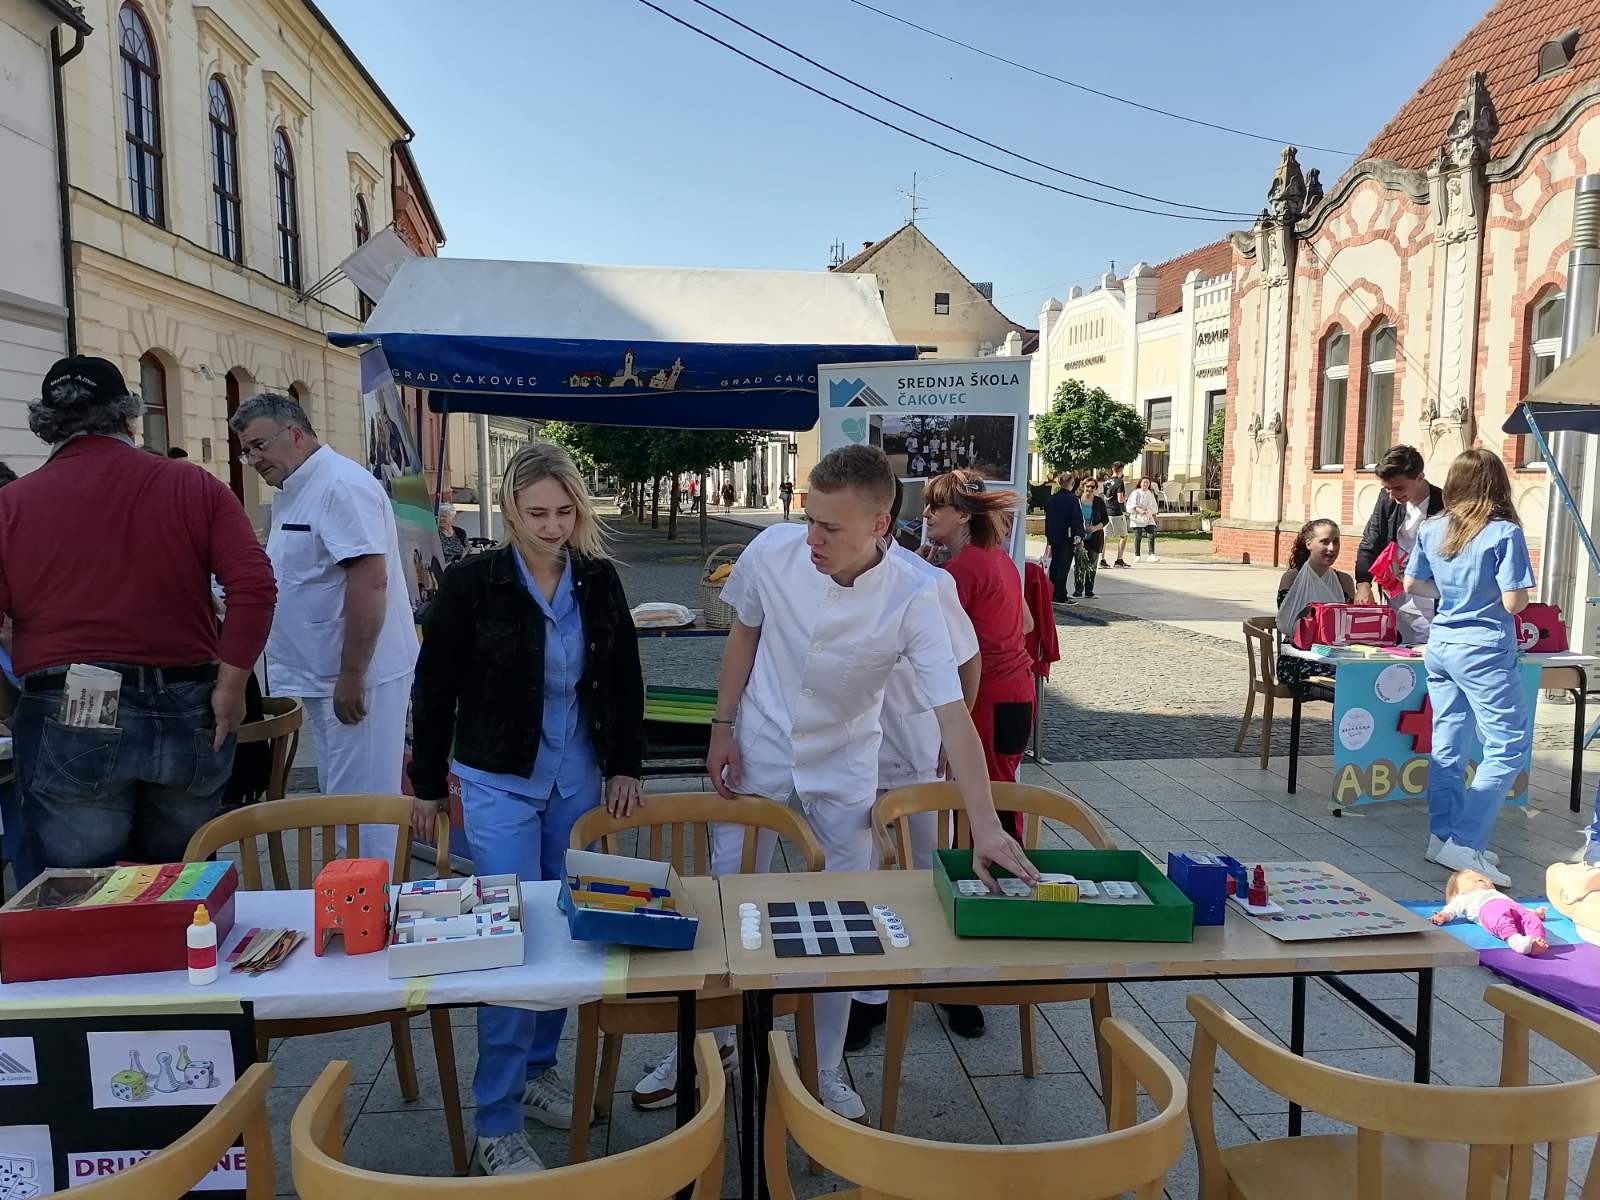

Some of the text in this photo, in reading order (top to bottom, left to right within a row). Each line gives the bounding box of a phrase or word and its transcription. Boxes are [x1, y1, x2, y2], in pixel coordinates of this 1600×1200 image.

[391, 368, 538, 386] GRAD ČAKOVEC
[720, 373, 816, 387] GRAD ČAKO
[897, 371, 1020, 390] SREDNJA ŠKOLA
[897, 392, 967, 406] ČAKOVEC
